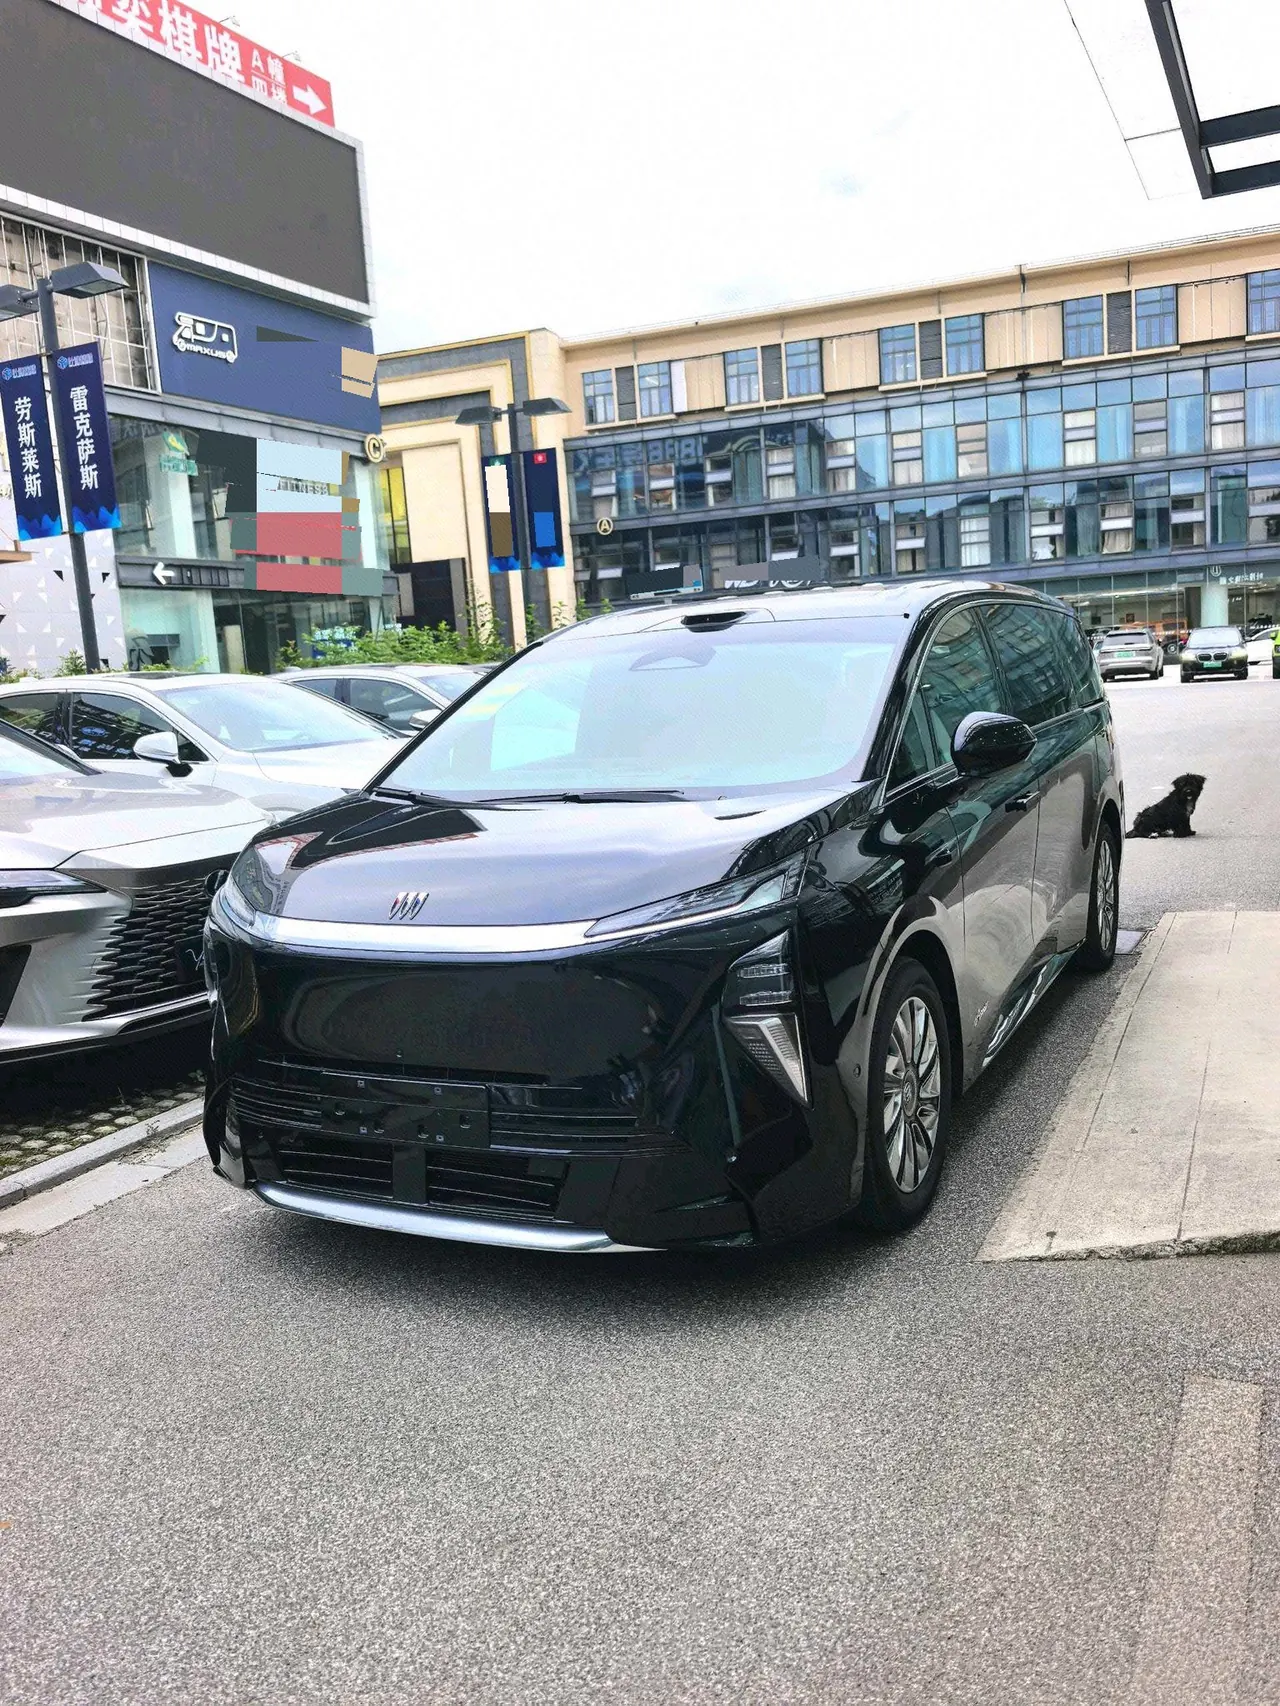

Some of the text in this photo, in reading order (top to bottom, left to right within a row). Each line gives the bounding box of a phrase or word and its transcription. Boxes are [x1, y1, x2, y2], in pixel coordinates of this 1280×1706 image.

[71, 0, 246, 83] 奕棋牌
[14, 396, 42, 499] 劳斯莱斯
[70, 385, 99, 490] 雷克萨斯
[369, 437, 381, 459] C
[600, 518, 611, 532] A
